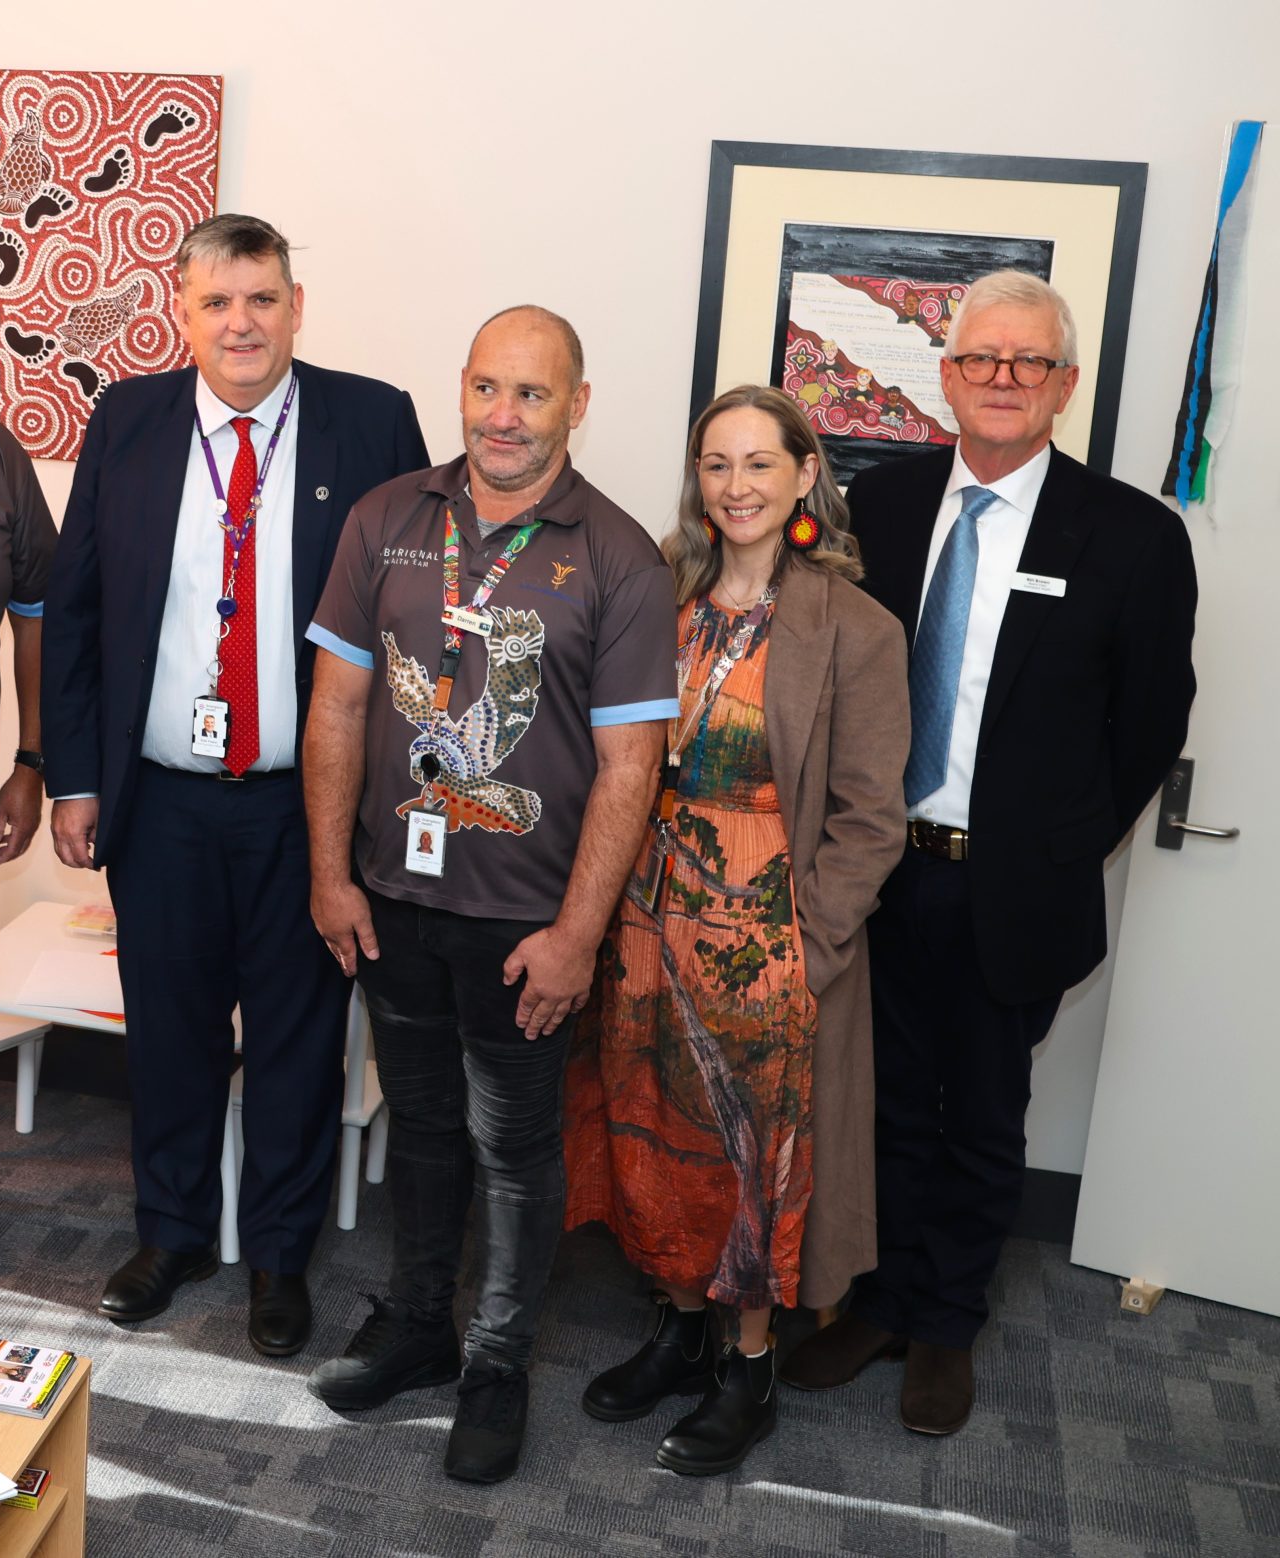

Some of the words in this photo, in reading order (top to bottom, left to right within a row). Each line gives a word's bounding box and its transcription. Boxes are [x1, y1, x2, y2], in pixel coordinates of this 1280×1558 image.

[380, 547, 439, 561] BRIGNAL
[412, 560, 429, 568] EAM
[457, 614, 476, 626] Darren
